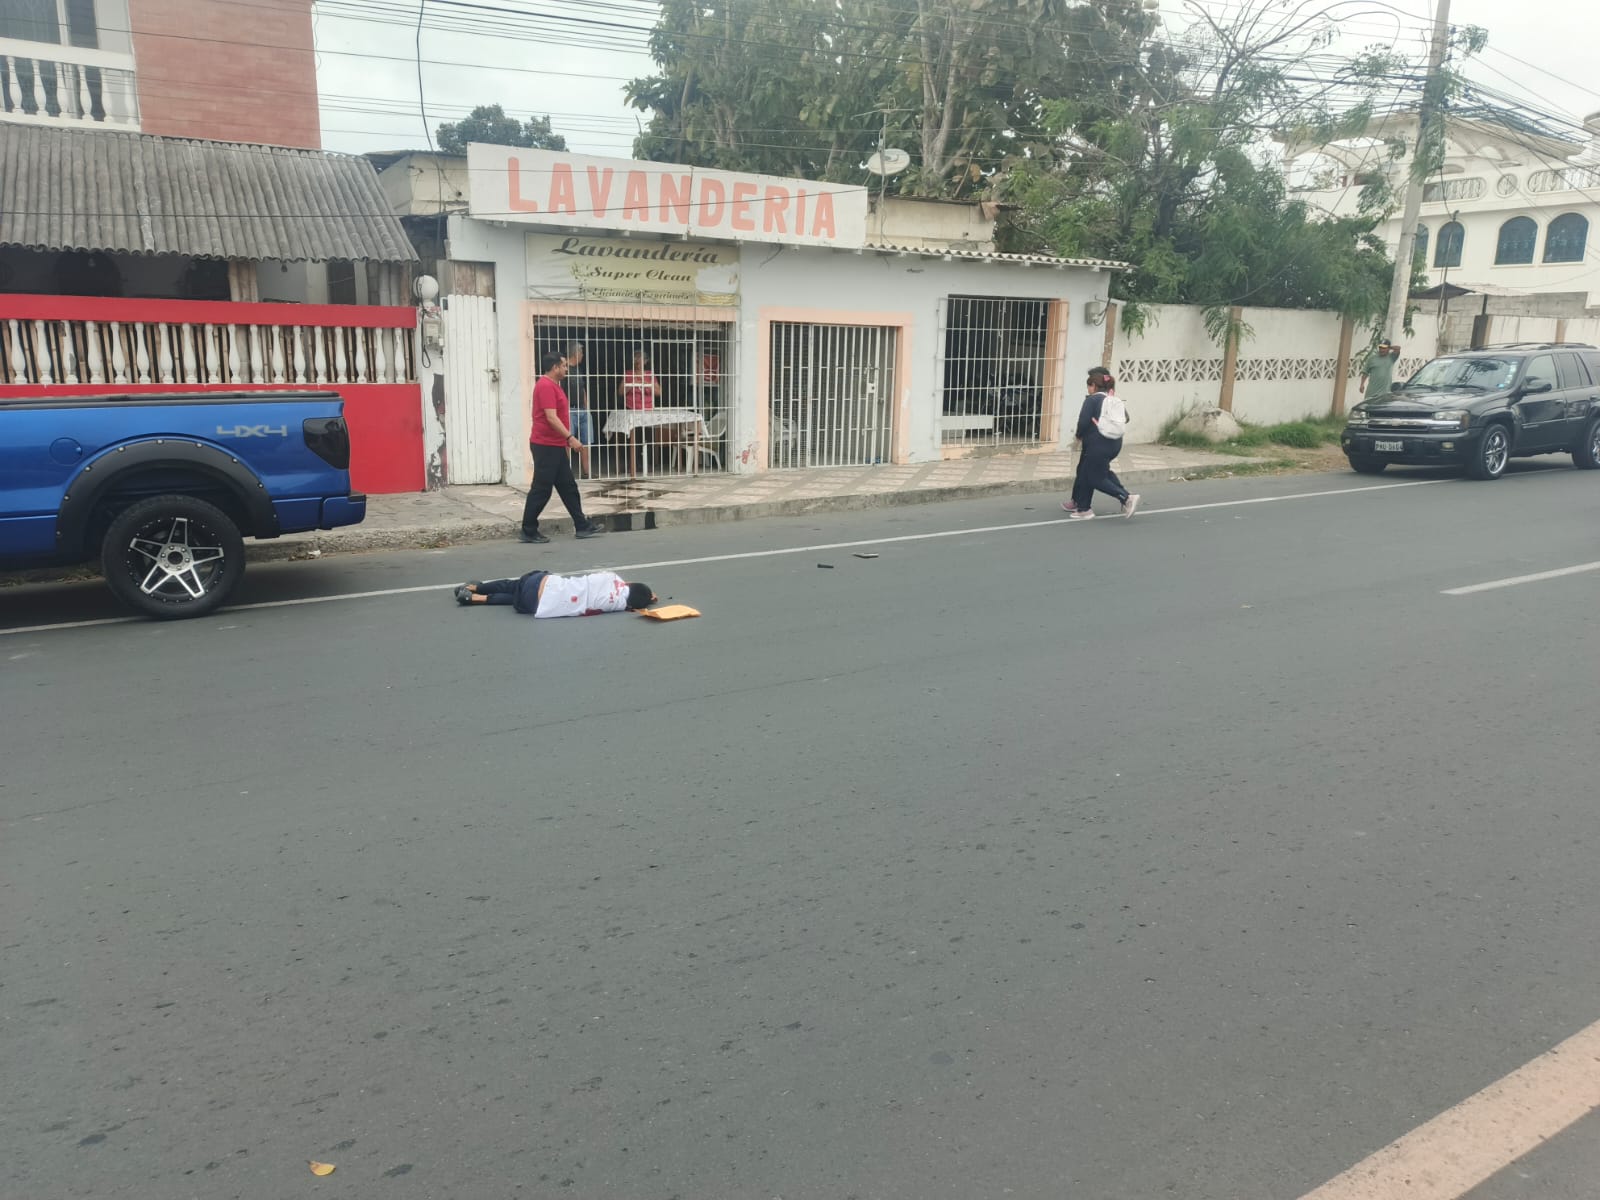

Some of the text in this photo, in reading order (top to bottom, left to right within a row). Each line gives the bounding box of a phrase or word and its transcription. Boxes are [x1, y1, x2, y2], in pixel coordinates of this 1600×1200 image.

[507, 157, 836, 239] LAVANDERIA
[552, 237, 719, 264] Lavandería
[590, 266, 692, 282] Super Clean
